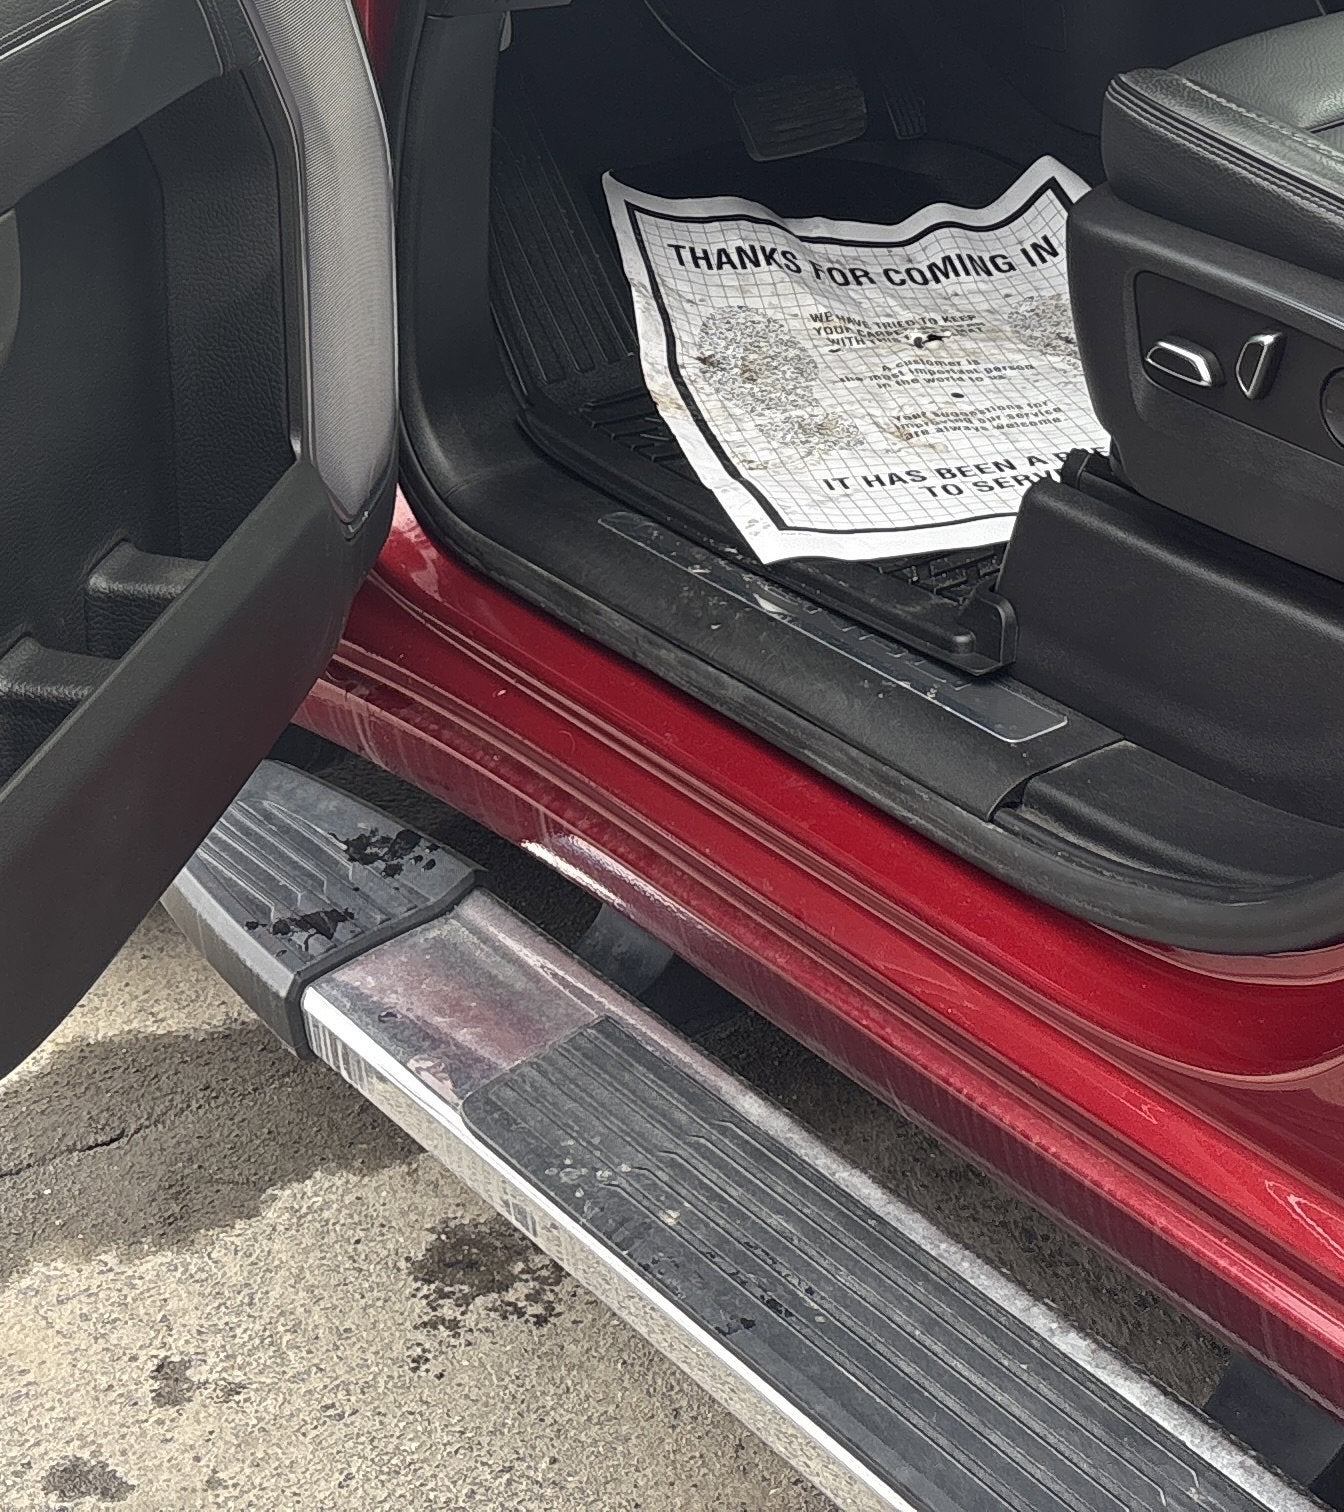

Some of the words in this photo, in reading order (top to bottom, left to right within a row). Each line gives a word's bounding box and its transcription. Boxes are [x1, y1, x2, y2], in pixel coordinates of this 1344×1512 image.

[667, 243, 802, 275] THANKS
[808, 259, 877, 287] FOR
[882, 252, 1017, 287] COMING
[1019, 233, 1060, 268] IN
[809, 310, 833, 323] WE
[835, 313, 871, 330] HAVE
[872, 319, 916, 330] TRIED
[918, 316, 938, 325] TO
[941, 314, 976, 323] KEEP
[812, 325, 852, 336] YOUR
[826, 336, 866, 347] WITH
[839, 375, 864, 384] the
[868, 370, 906, 382] most
[908, 367, 979, 377] important
[983, 363, 1036, 375] person
[881, 365, 892, 373] A
[895, 358, 962, 369] customer
[966, 358, 981, 366] is
[895, 377, 920, 387] the
[923, 375, 965, 384] world
[968, 375, 984, 383] to
[930, 403, 1024, 418] suggestions
[1027, 399, 1049, 409] for
[977, 414, 1002, 425] our
[1006, 406, 1062, 420] service
[904, 428, 930, 440] are
[935, 424, 989, 433] always
[992, 416, 1068, 430] welcome.
[822, 476, 852, 491] IT
[861, 469, 928, 488] HAS
[934, 459, 1018, 481] BEEN
[1026, 455, 1049, 467] A
[919, 483, 964, 498] TO
[972, 468, 1062, 493] SERV
